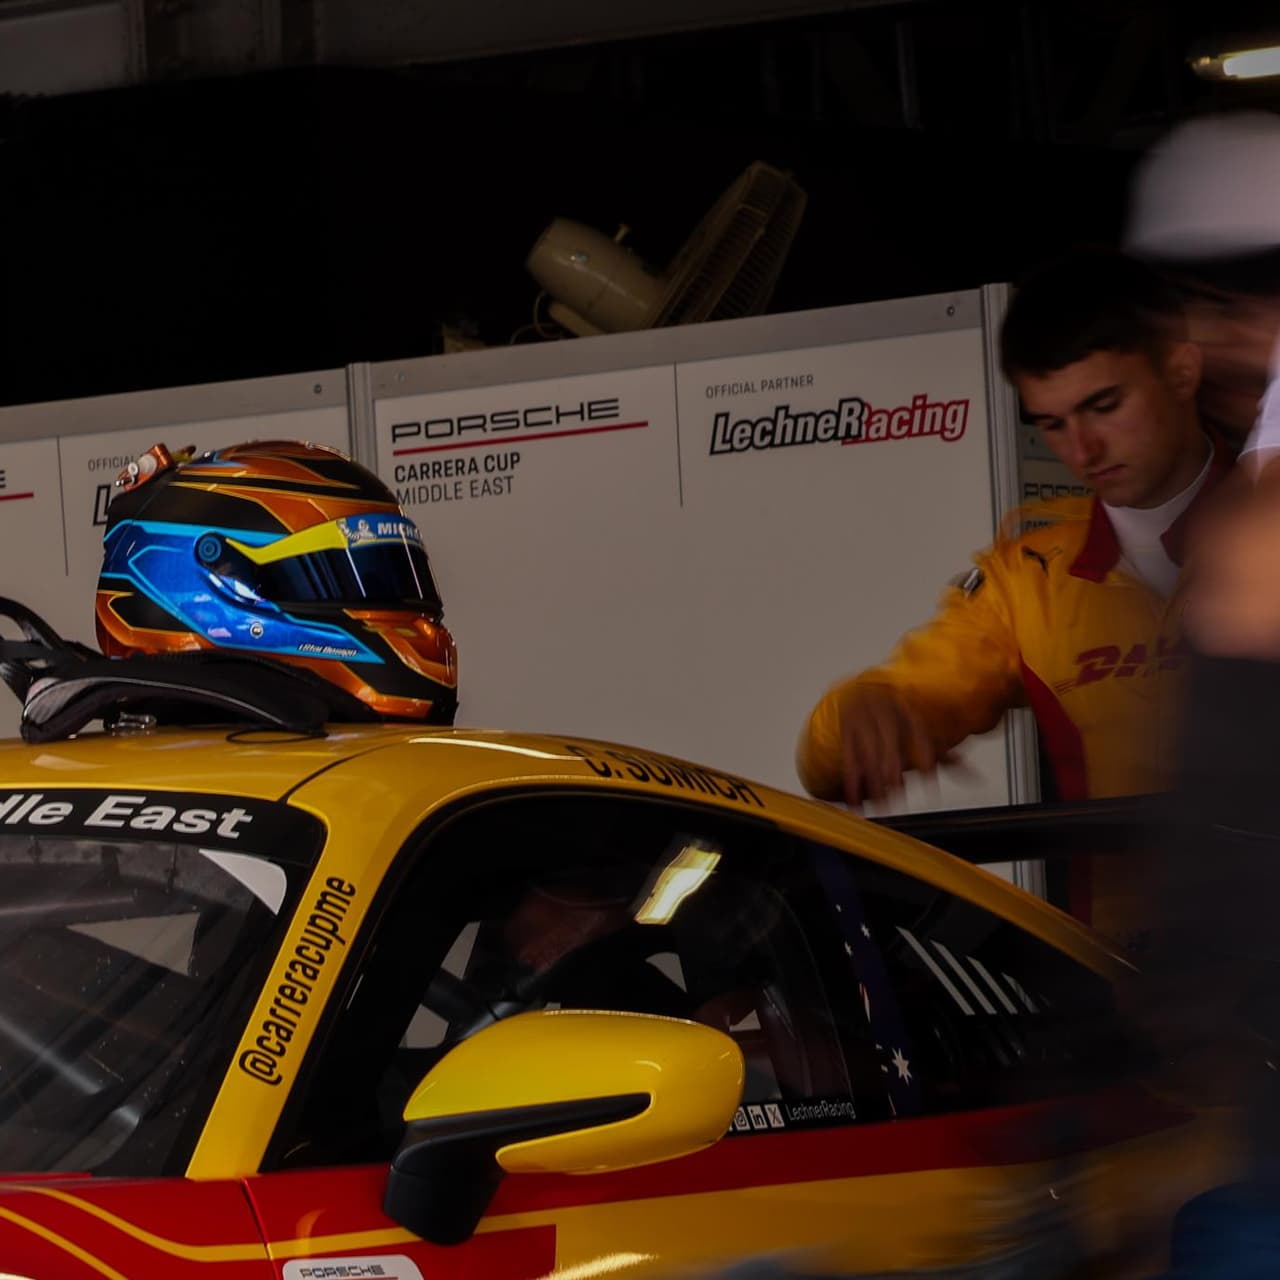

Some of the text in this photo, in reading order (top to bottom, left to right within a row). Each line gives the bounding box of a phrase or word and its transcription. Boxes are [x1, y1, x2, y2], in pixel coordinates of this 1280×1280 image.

[705, 374, 815, 399] OFFICIAL PARTNER
[392, 397, 620, 444] PORSCHE
[394, 451, 521, 483] CARRERA CUP
[396, 475, 515, 506] MIDDLE EAST
[84, 794, 253, 841] East
[239, 874, 357, 1086] @carreracupme
[300, 1264, 385, 1278] PORSCHE
